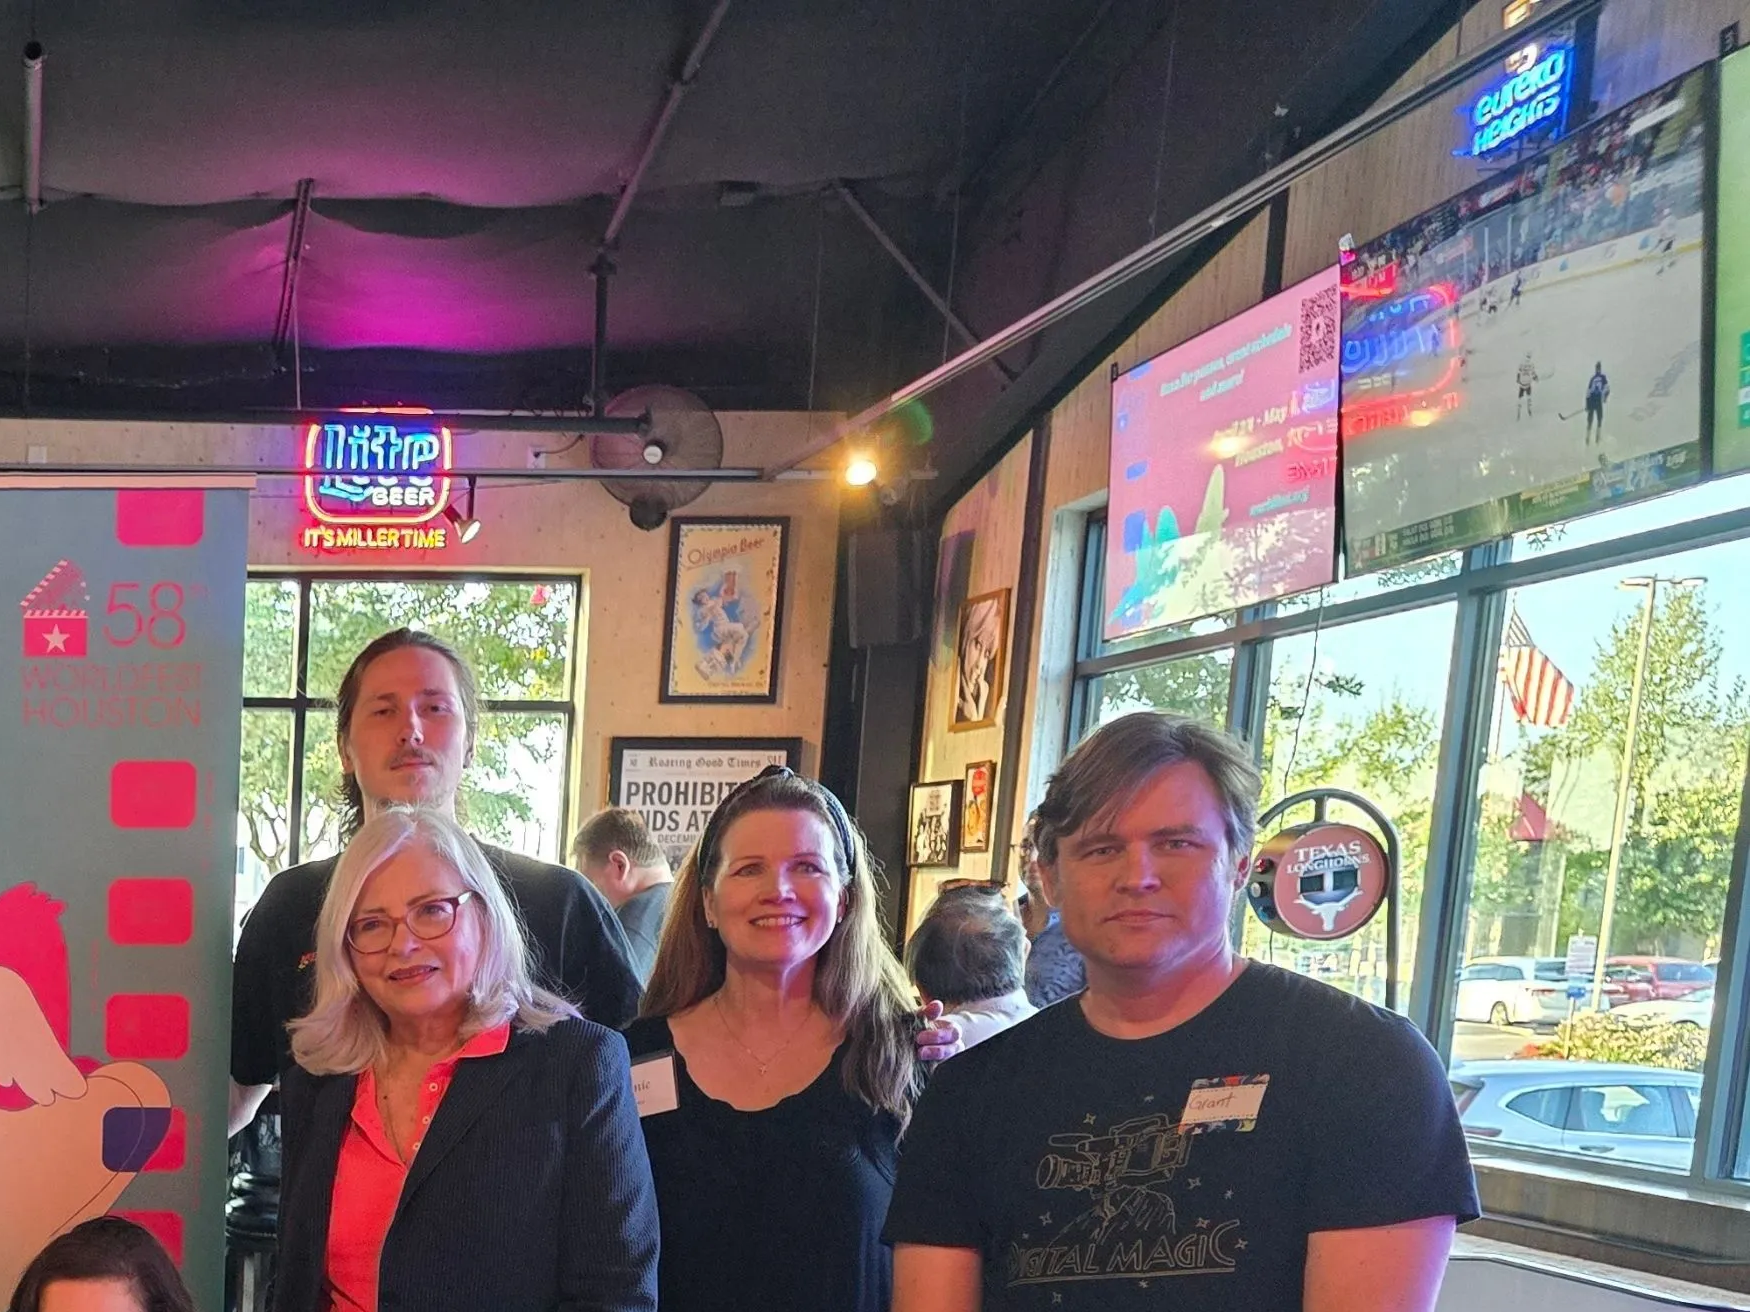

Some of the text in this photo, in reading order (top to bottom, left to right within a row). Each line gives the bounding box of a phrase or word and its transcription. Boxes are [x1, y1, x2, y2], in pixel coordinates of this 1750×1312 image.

[371, 486, 436, 506] BEER
[304, 525, 447, 549] IT'S MILLER TIME
[687, 543, 738, 566] Olympia
[21, 661, 203, 693] WORLDFEST
[22, 696, 201, 729] HOUSTON
[648, 752, 692, 769] Roaring
[695, 752, 724, 768] Good
[727, 752, 762, 768] Times
[625, 781, 741, 806] PROHIBIT
[636, 810, 680, 832] NDS
[657, 834, 696, 844] DECEM
[1294, 840, 1362, 862] TEXAS
[1286, 852, 1371, 874] LONGHORNS
[1188, 1091, 1237, 1111] Grant
[1106, 1219, 1241, 1272] MAGIC
